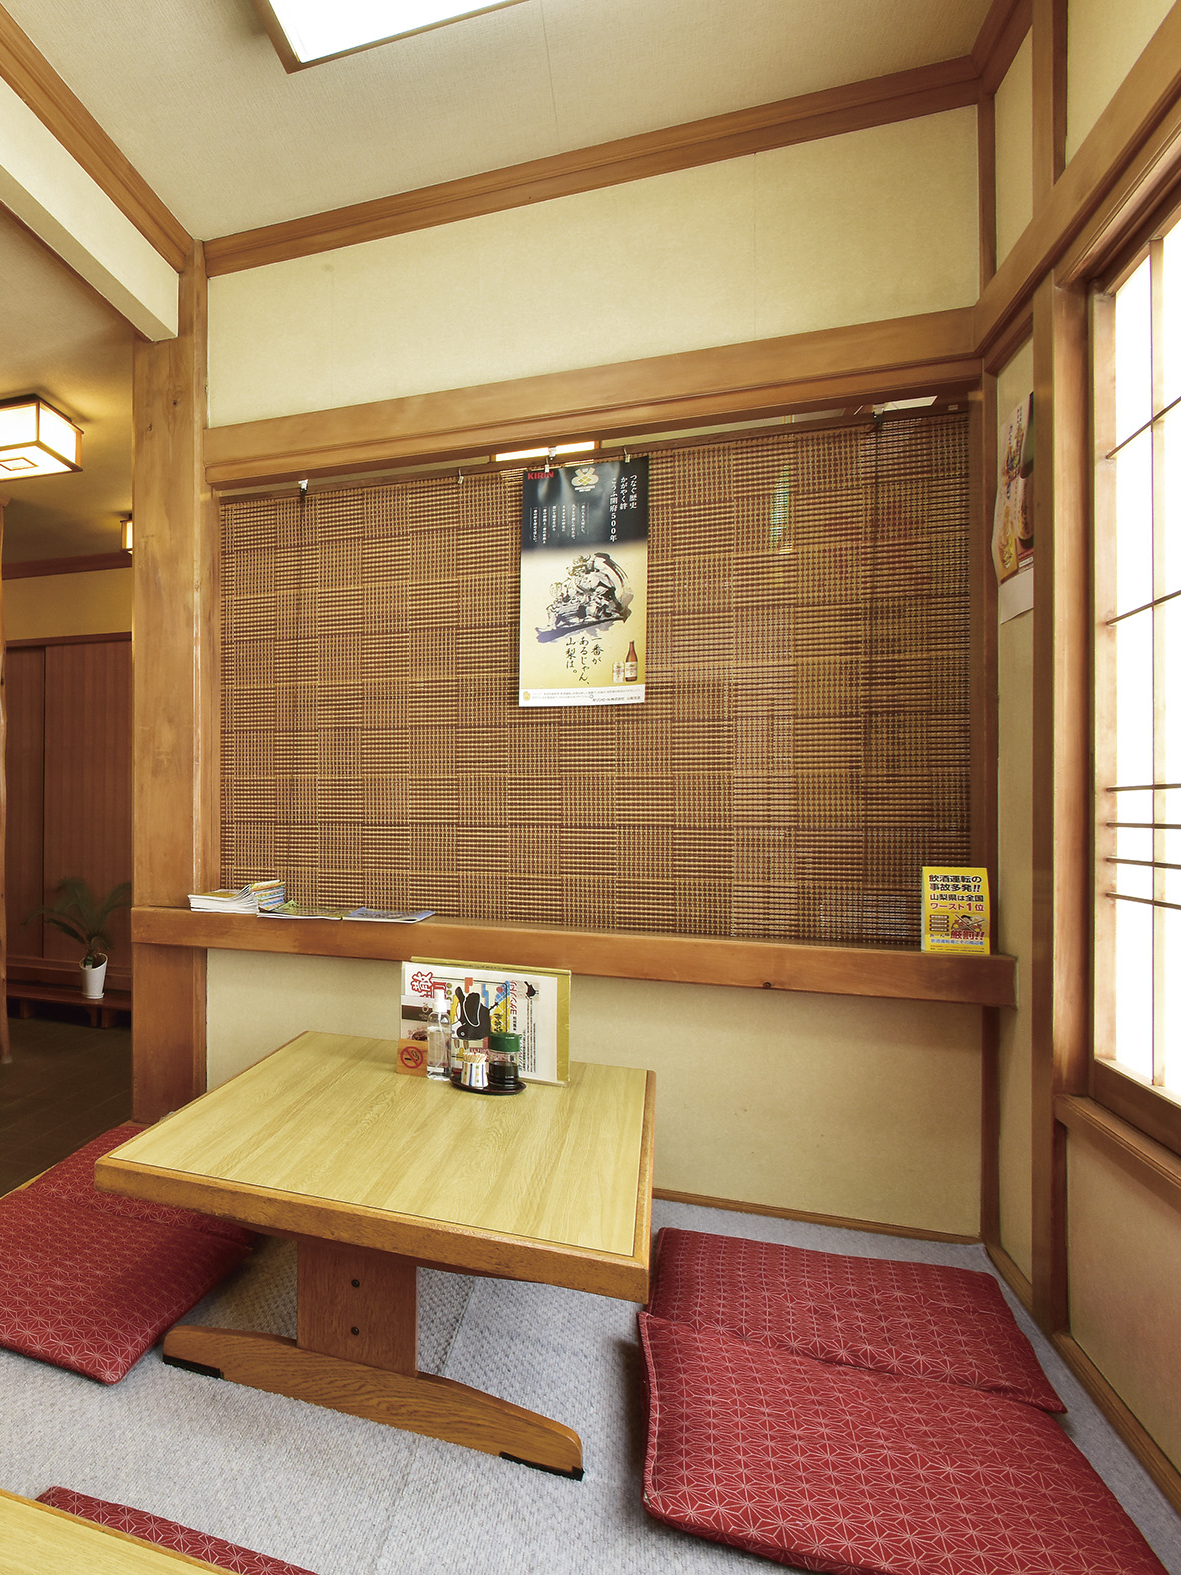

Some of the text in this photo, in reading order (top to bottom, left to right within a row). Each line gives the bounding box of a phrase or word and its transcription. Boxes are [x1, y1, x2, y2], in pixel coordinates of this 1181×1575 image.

[527, 471, 554, 480] KIRIN
[619, 476, 628, 510] かがやく絆
[629, 474, 638, 510] つなぐ歴史
[565, 637, 578, 674] 山梨は。
[578, 636, 590, 685] あるじゃん、
[590, 637, 604, 665] 一番が
[928, 874, 982, 883] 飲酒運転の
[929, 883, 981, 892] 事故多発!!
[929, 893, 985, 902] 山梨県は全国
[930, 902, 985, 912] ワースト1位
[509, 980, 518, 1015] ヨゲンノトリ
